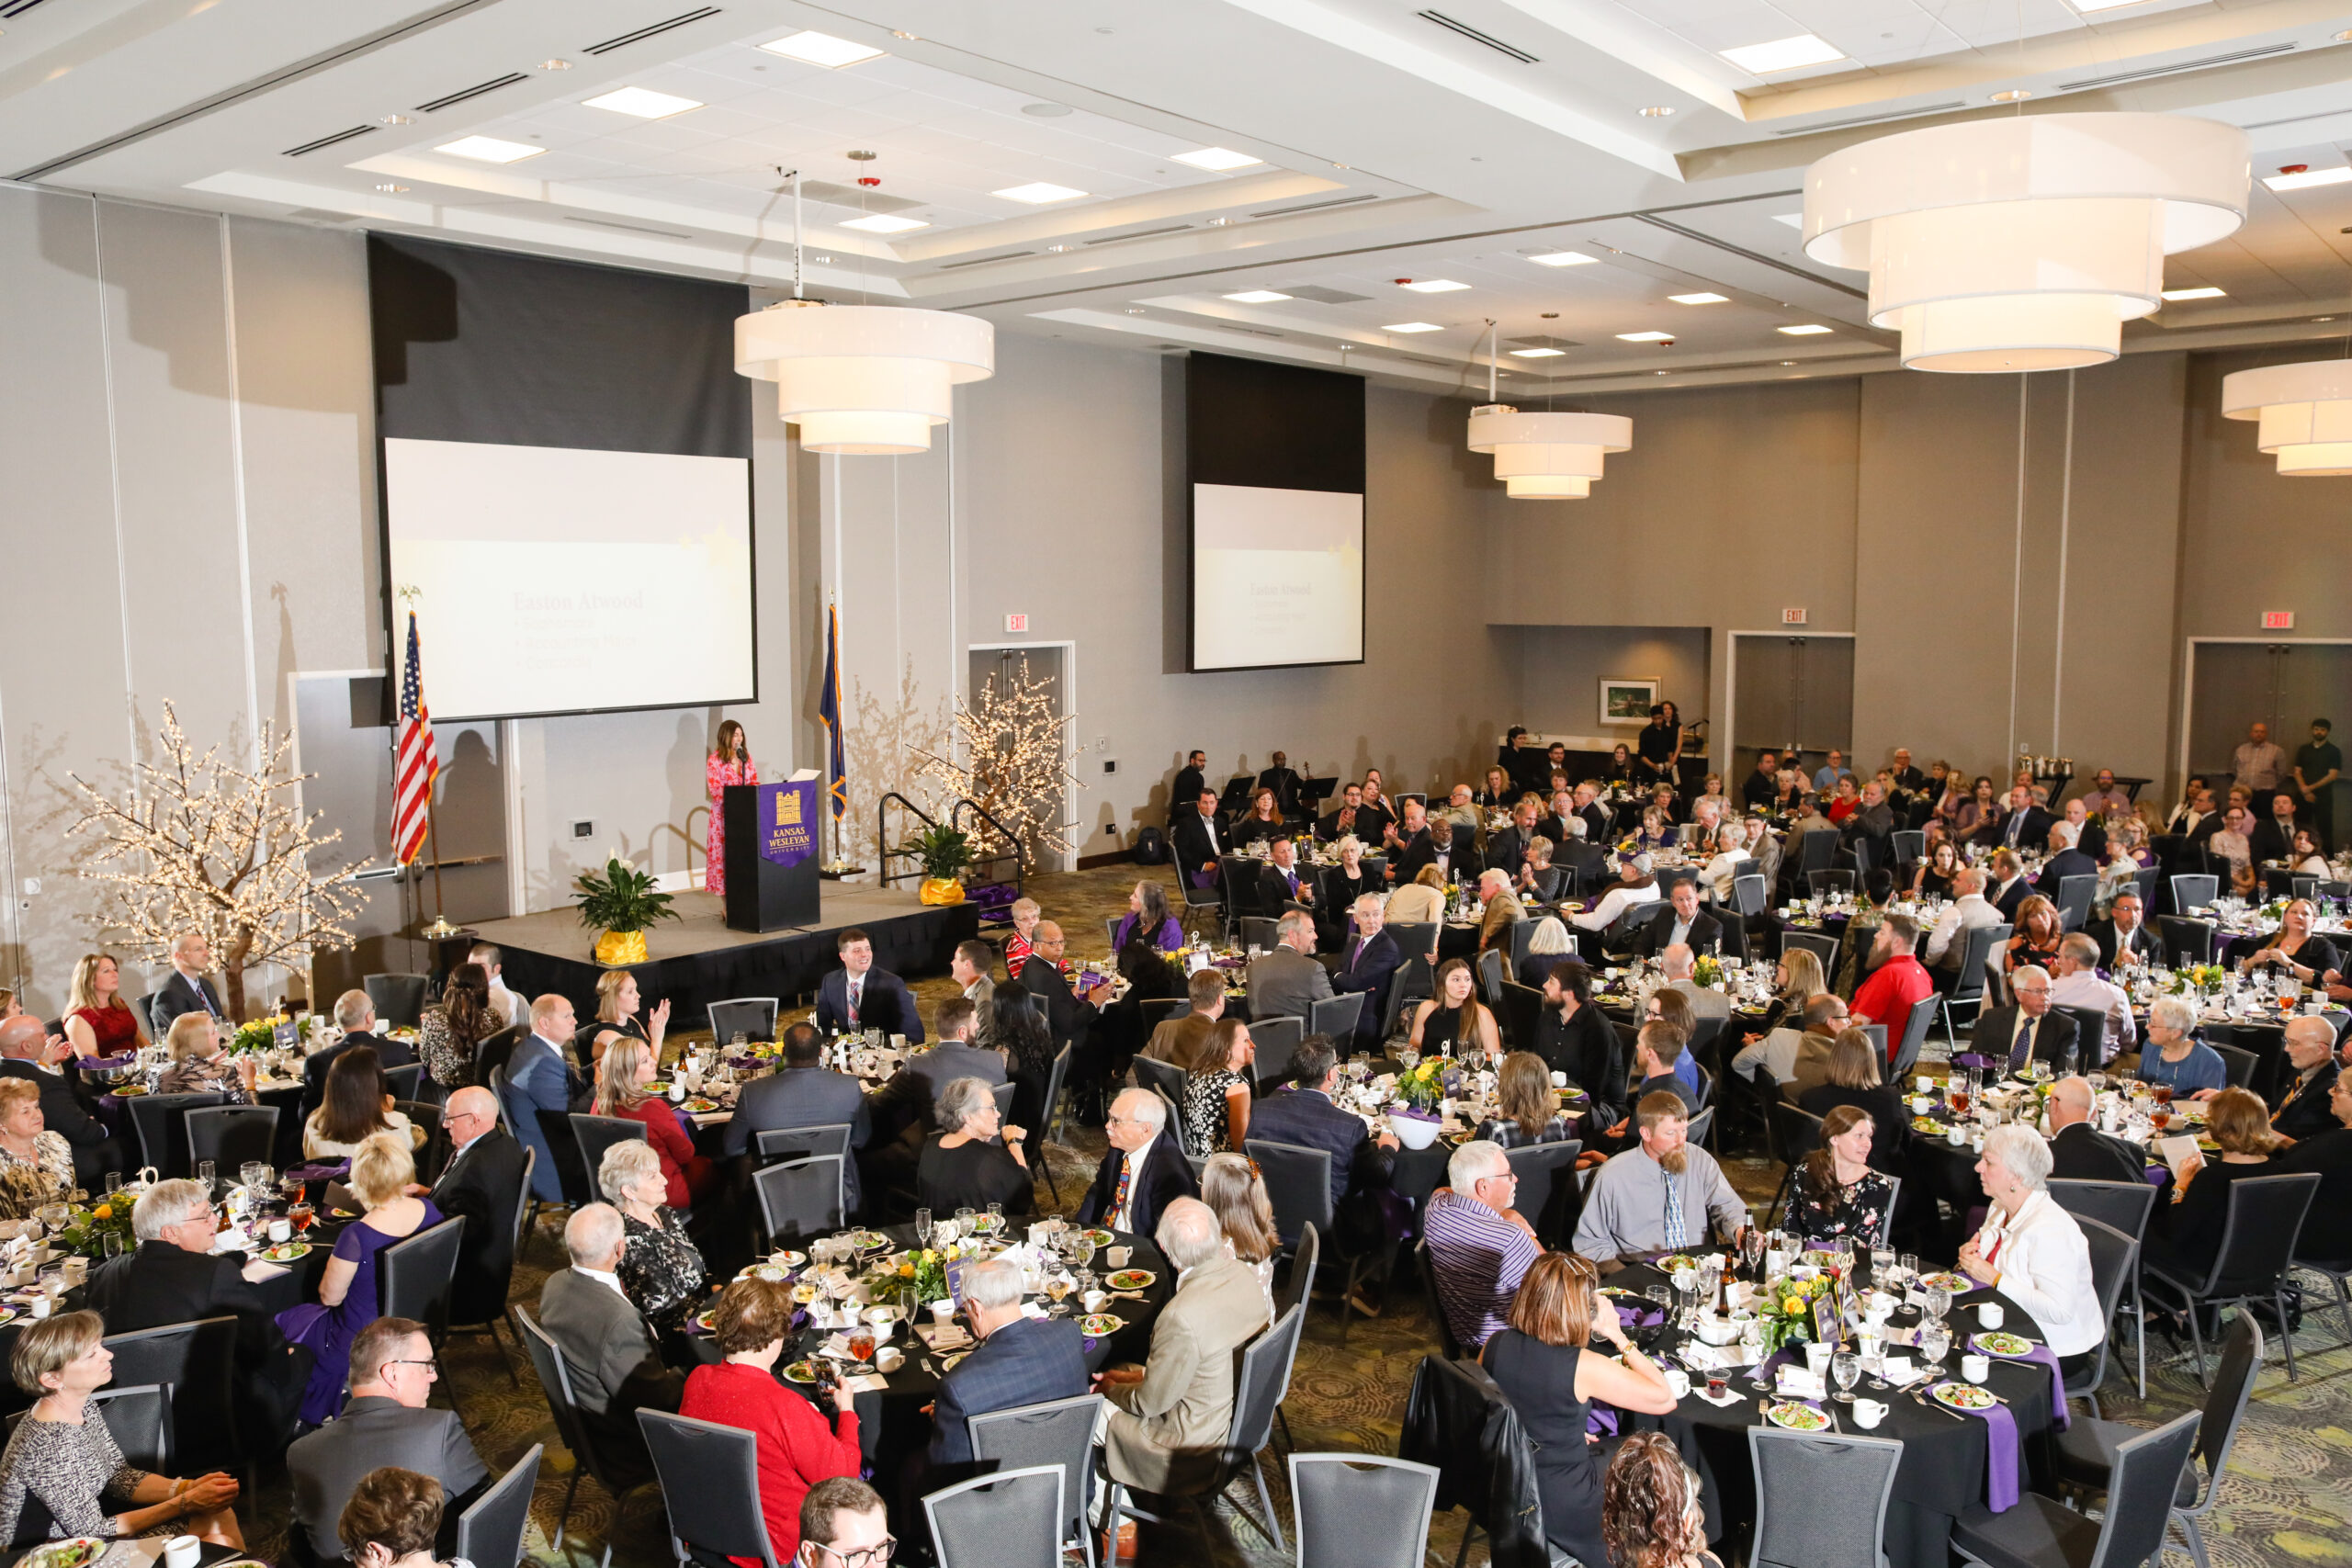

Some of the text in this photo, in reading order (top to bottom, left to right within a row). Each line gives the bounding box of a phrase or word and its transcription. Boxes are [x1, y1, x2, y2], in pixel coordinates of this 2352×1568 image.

[514, 589, 645, 611] Easton Atwood
[1011, 615, 1026, 630] EXIT
[1786, 609, 1803, 622] EXIT
[2267, 612, 2290, 627] EXIT
[773, 826, 806, 838] KANSAS
[769, 834, 810, 847] WESLEYAN
[770, 845, 810, 854] UNIVERSITY
[271, 995, 284, 1017] 4
[807, 1010, 818, 1028] 11
[135, 1166, 159, 1190] 10
[937, 1218, 961, 1247] 20
